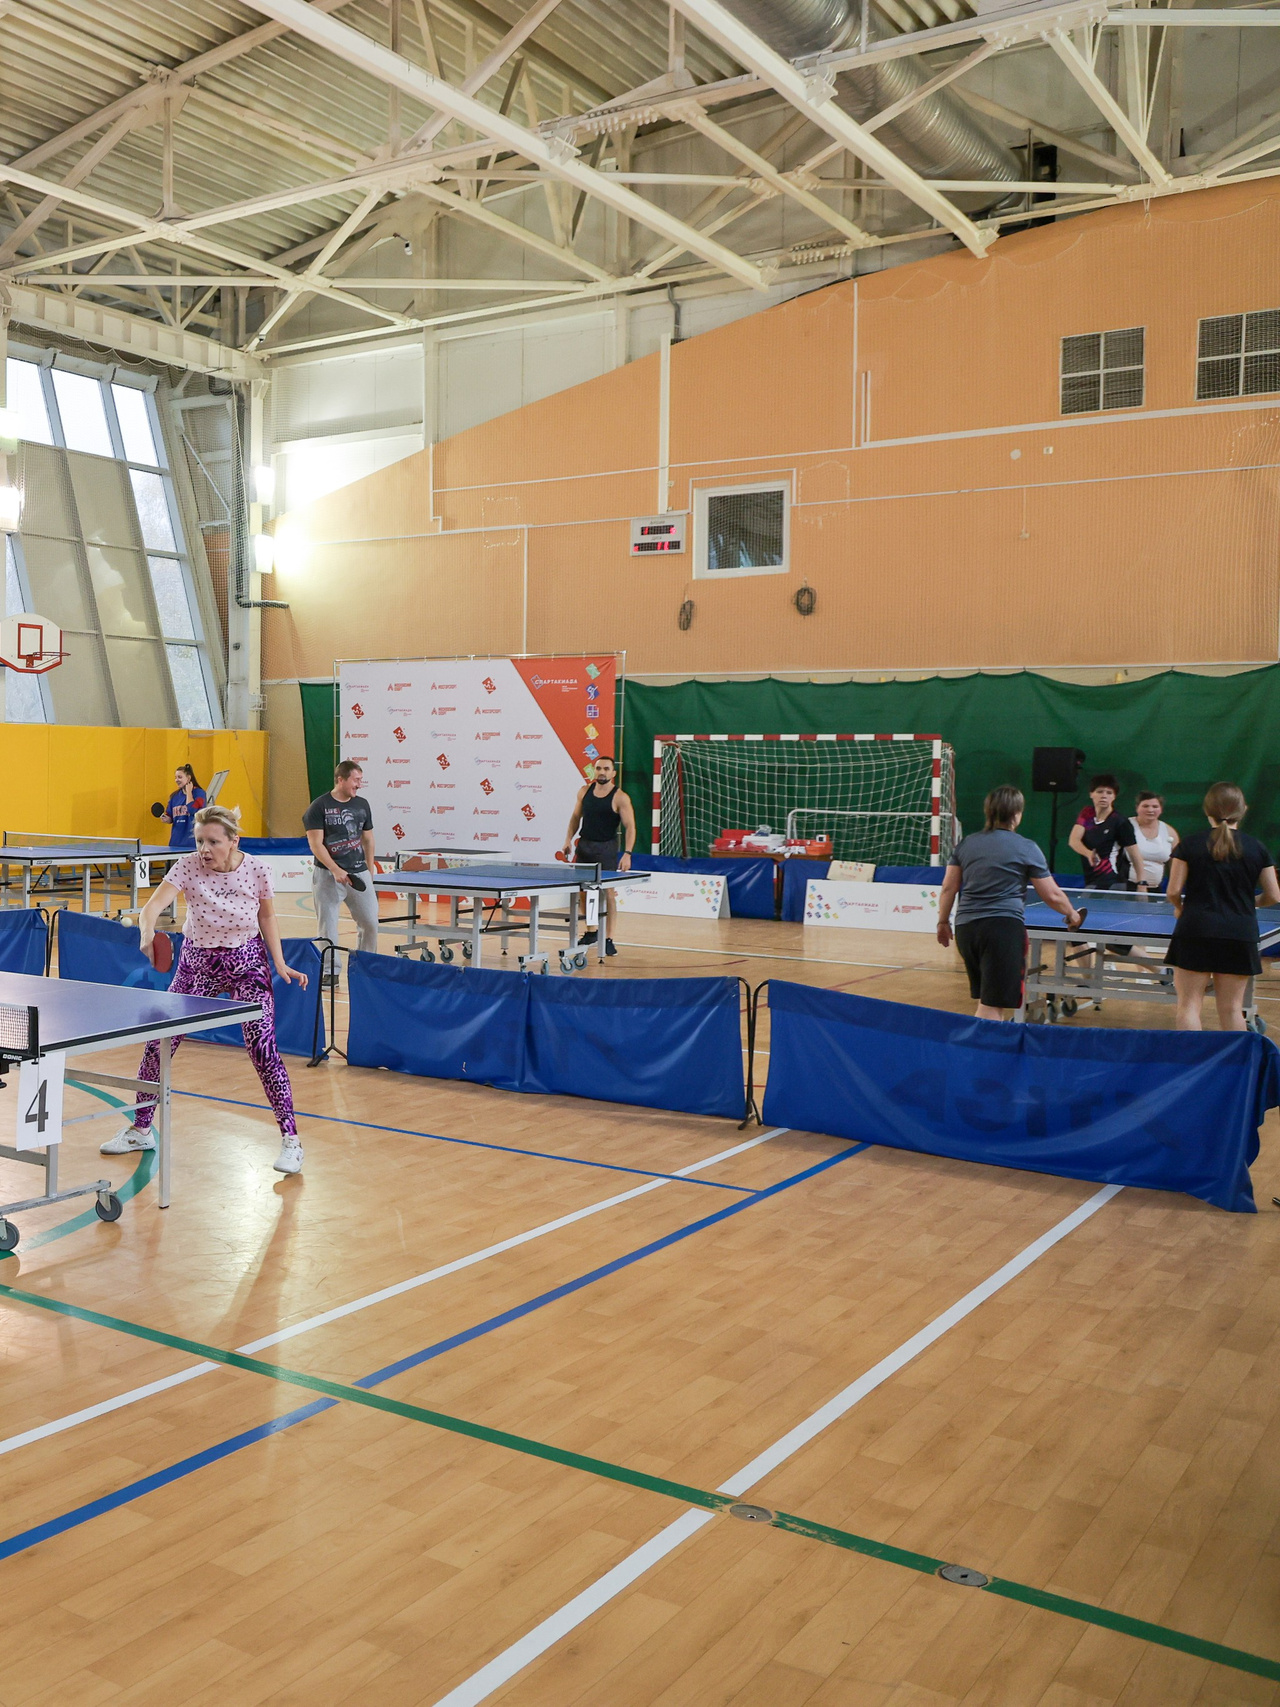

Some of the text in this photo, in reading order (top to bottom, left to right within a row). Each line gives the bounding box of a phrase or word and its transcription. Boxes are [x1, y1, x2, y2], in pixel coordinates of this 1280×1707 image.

[139, 861, 147, 880] 8
[589, 898, 596, 920] 7
[2, 1053, 23, 1061] DONIC
[24, 1079, 49, 1133] 4
